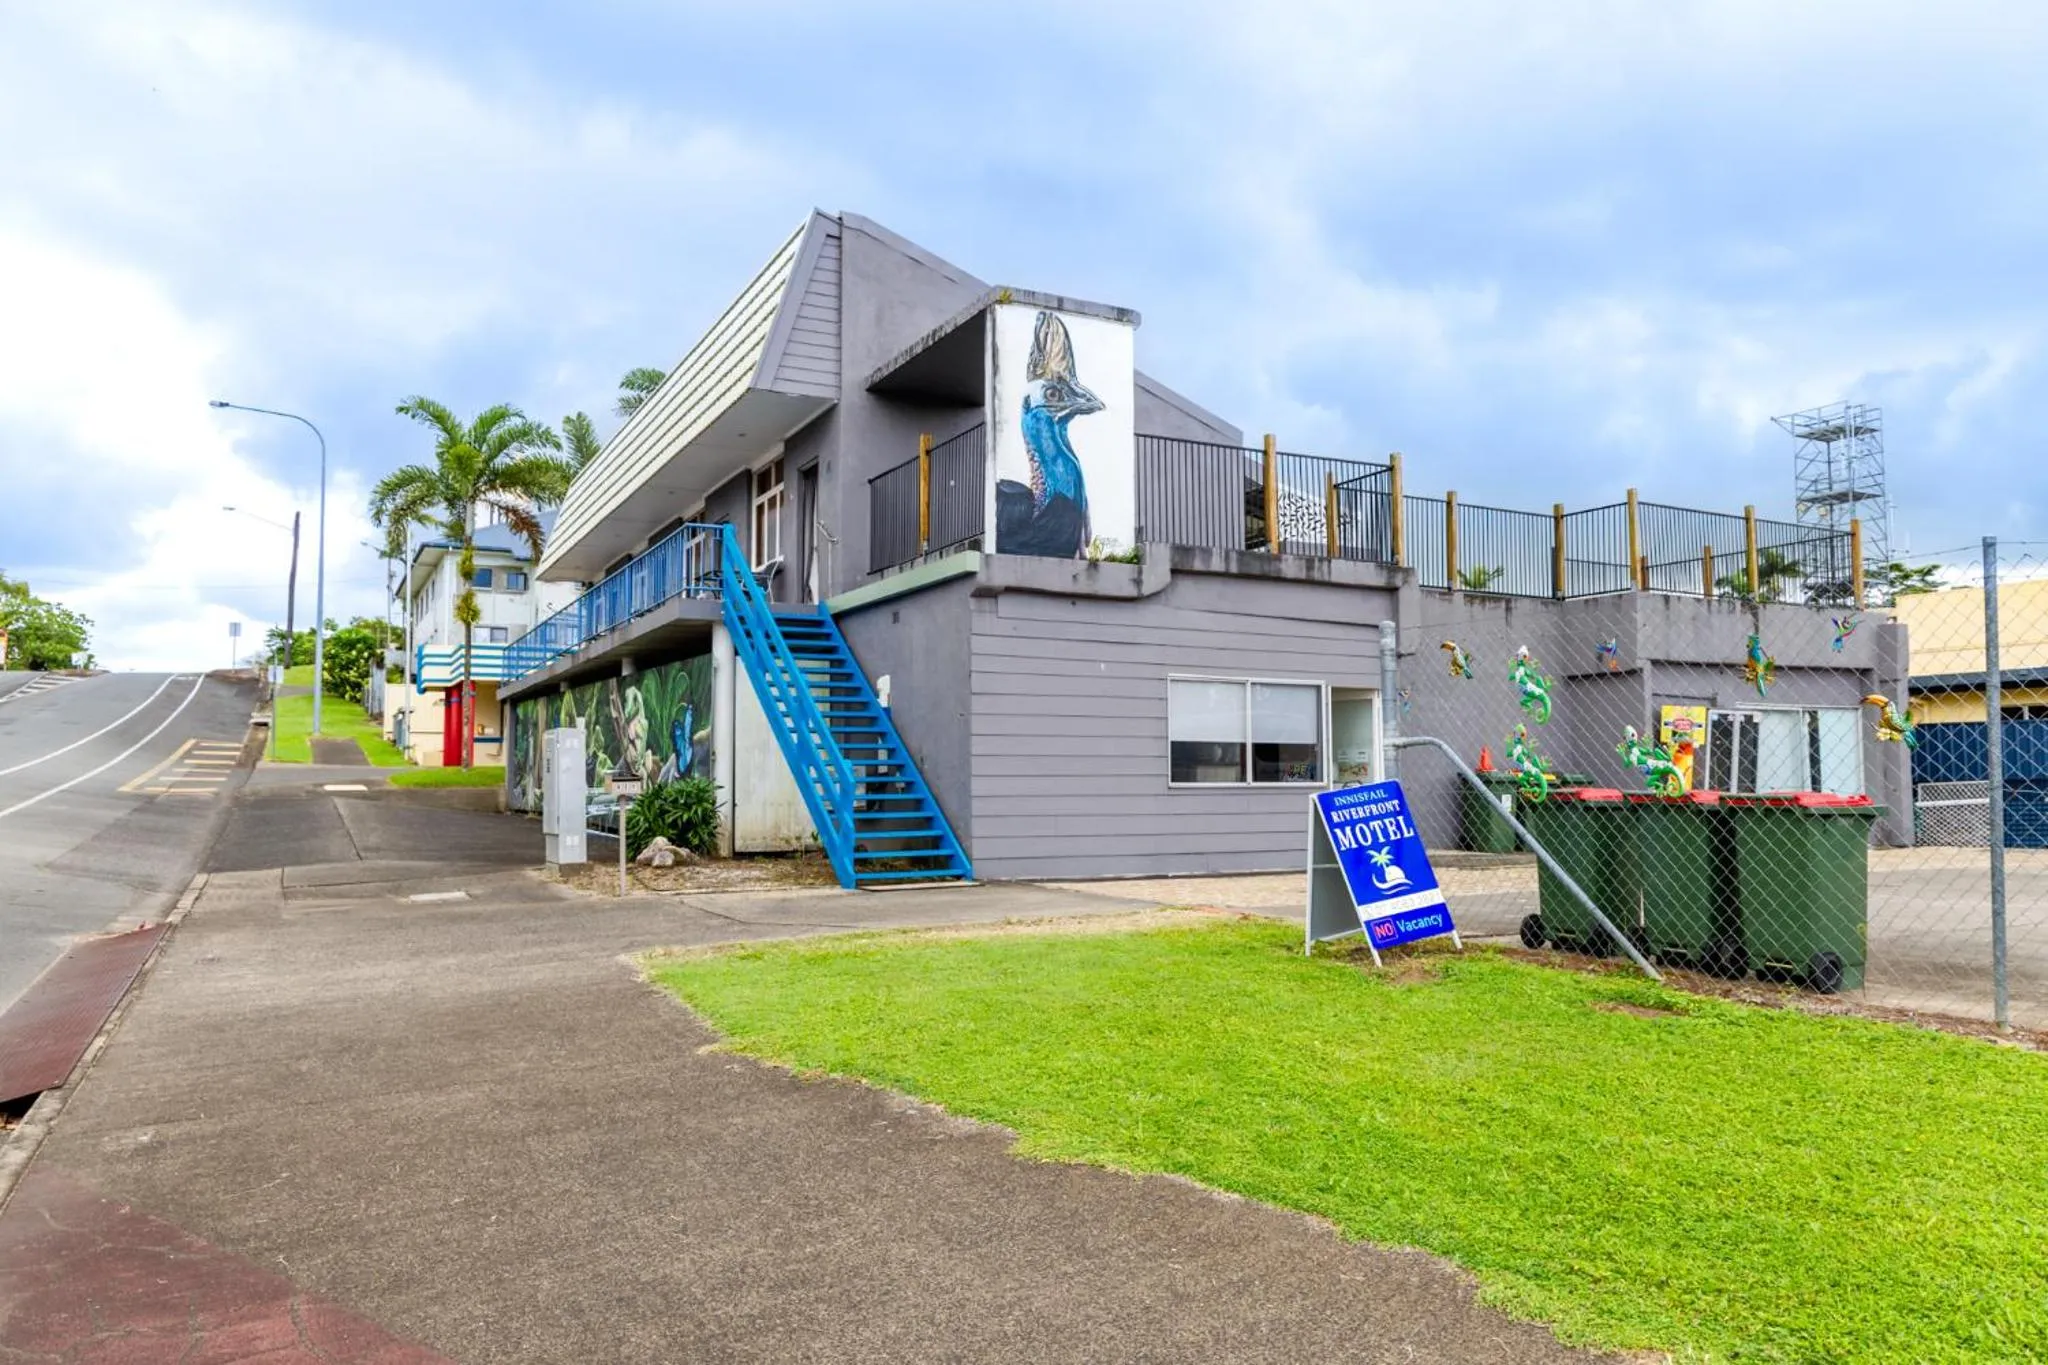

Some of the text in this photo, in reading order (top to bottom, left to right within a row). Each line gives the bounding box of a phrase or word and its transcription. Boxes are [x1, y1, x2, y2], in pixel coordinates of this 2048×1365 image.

[1334, 789, 1388, 807] INNISFAIL
[1331, 800, 1400, 823] RIVERFRONT
[1333, 816, 1414, 851] MOTEL
[1374, 914, 1443, 938] NO Vacancy
